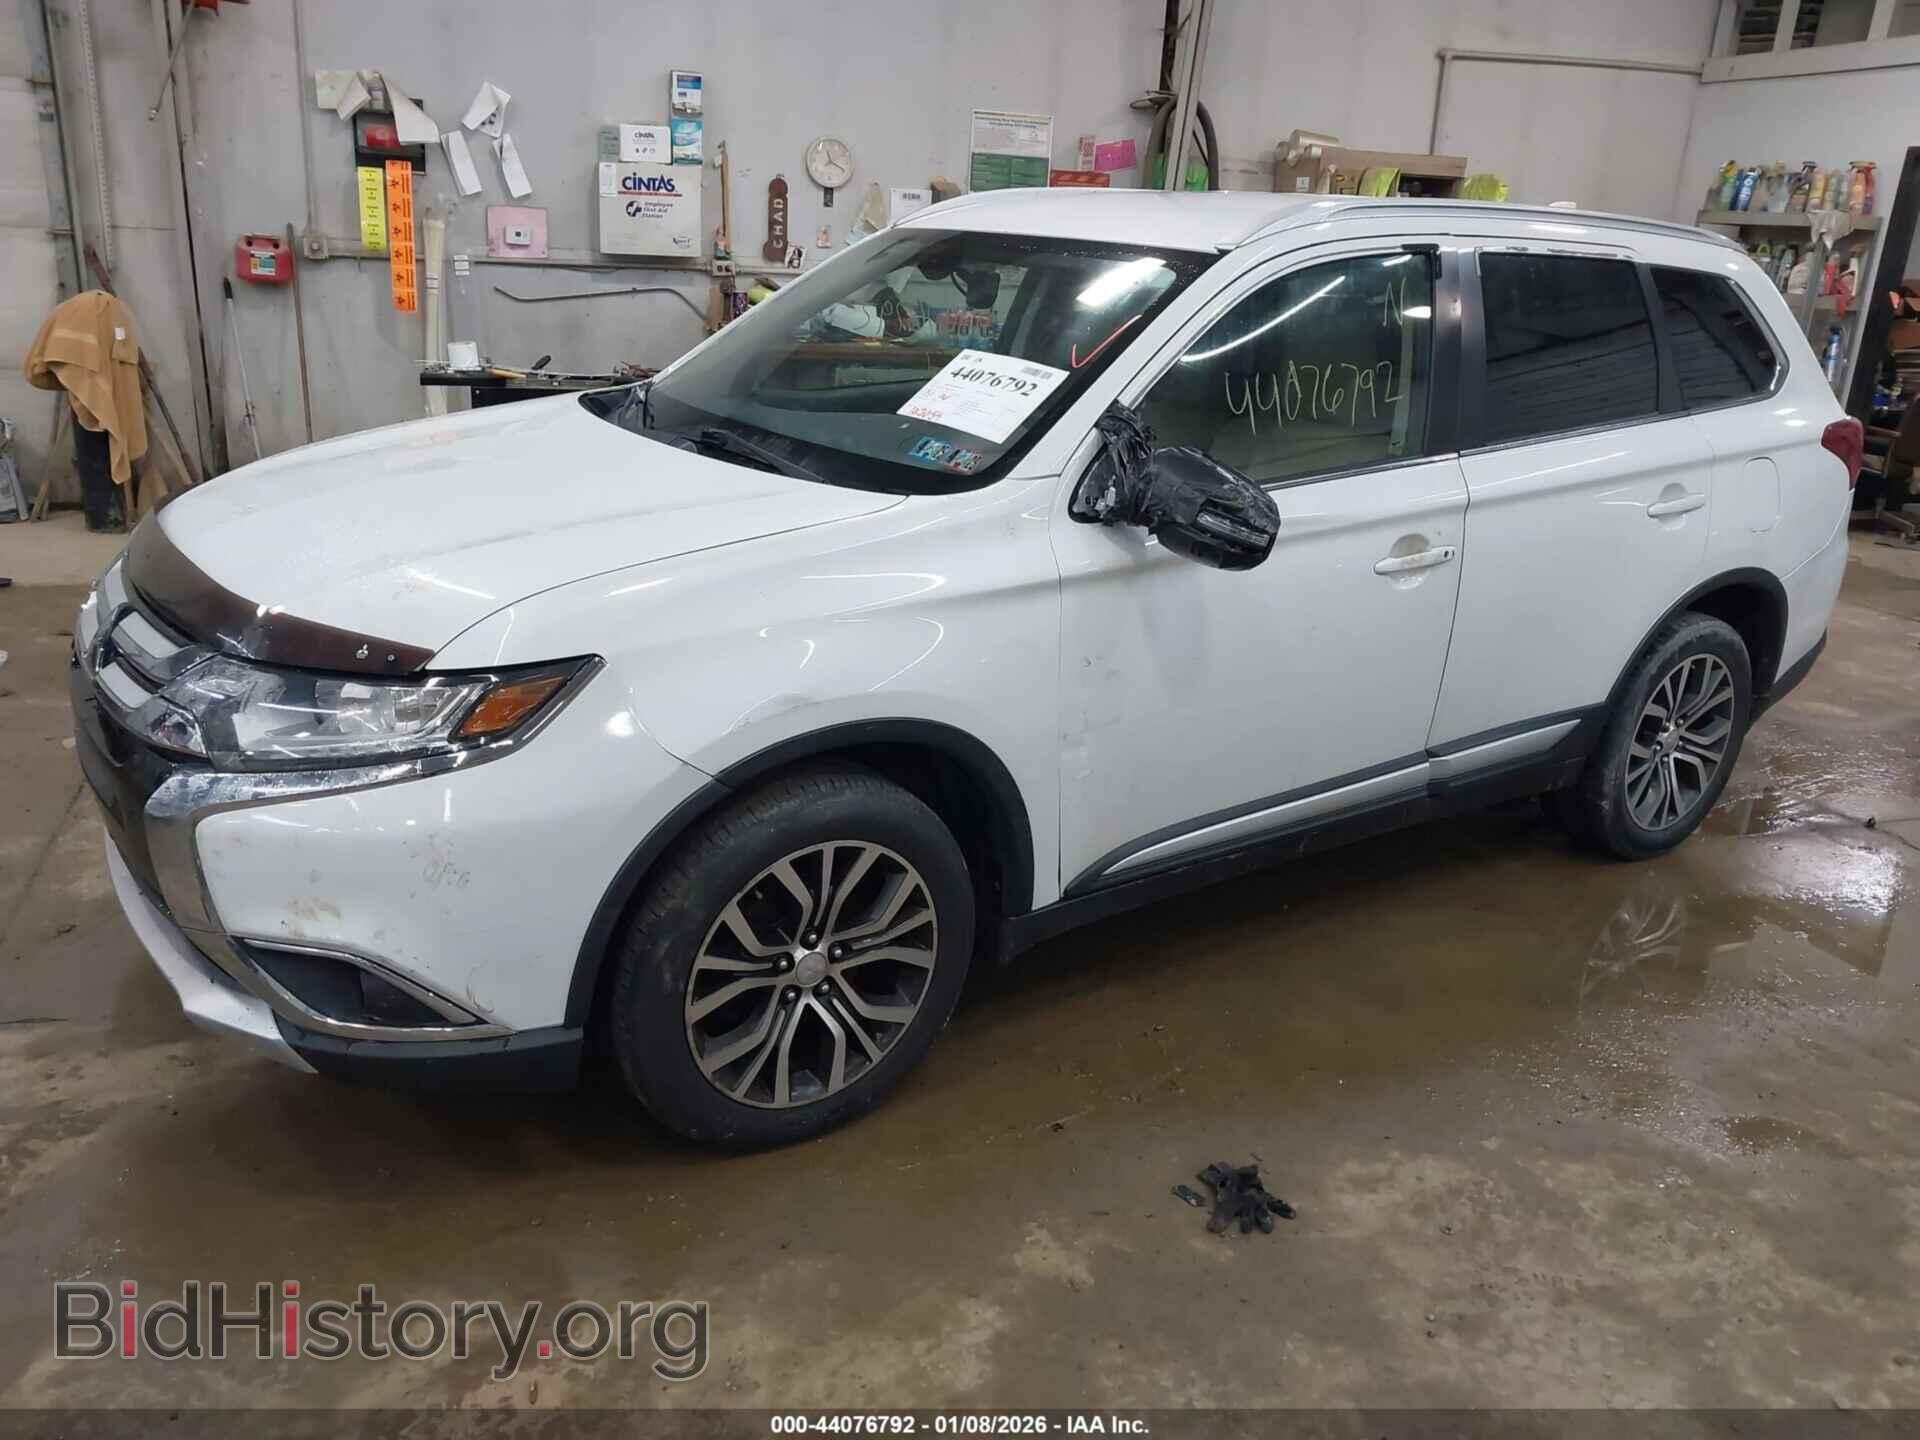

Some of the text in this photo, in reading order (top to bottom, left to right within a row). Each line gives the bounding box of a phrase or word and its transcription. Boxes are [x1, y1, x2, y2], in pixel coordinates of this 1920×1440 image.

[772, 198, 785, 249] CHAD
[950, 366, 1038, 397] 44076792
[1224, 360, 1404, 436] 44076792
